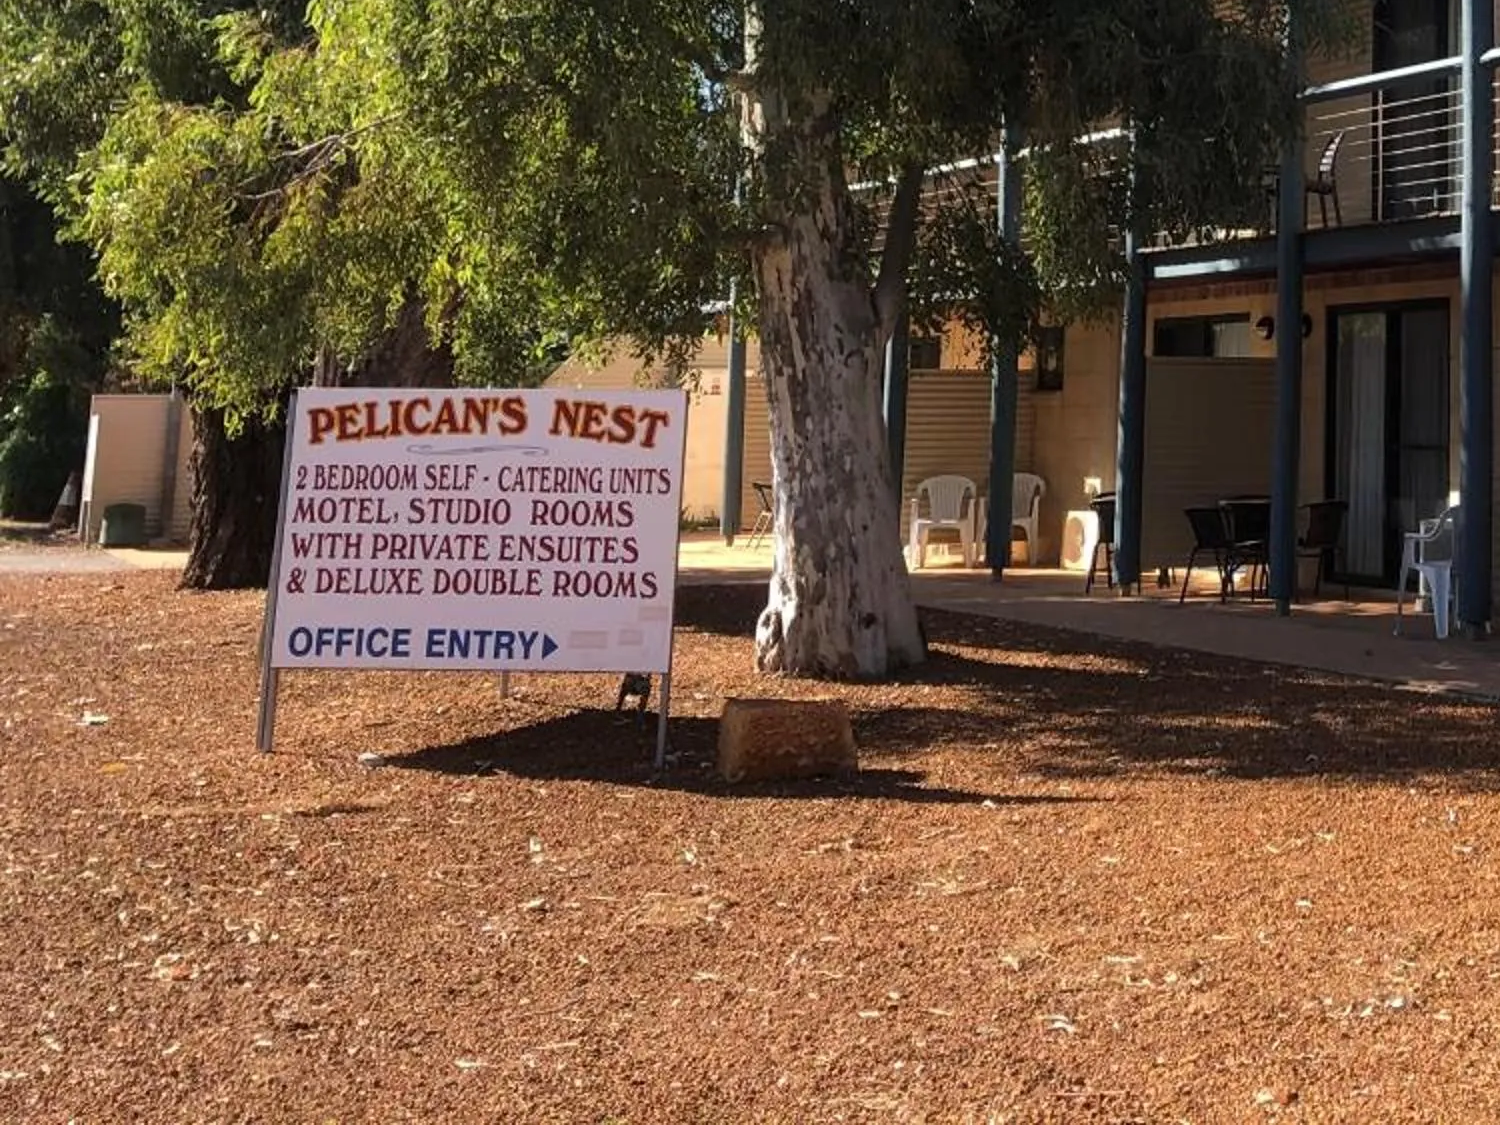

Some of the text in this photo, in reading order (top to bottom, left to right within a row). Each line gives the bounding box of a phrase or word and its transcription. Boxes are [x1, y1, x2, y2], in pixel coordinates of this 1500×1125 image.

[307, 395, 670, 448] PELICAN'S NEST
[295, 466, 307, 491] 2
[313, 465, 417, 491] BEDROOM
[498, 468, 602, 494] CATERING
[610, 468, 671, 495] UNITS
[408, 498, 511, 525] STUDIO
[530, 500, 634, 527] ROOMS
[291, 534, 639, 564] WITH PRIVATE ENSUITES
[286, 568, 657, 599] & DELUXE DOUBLE ROOMS
[288, 627, 539, 660] OFFICE ENTRY
